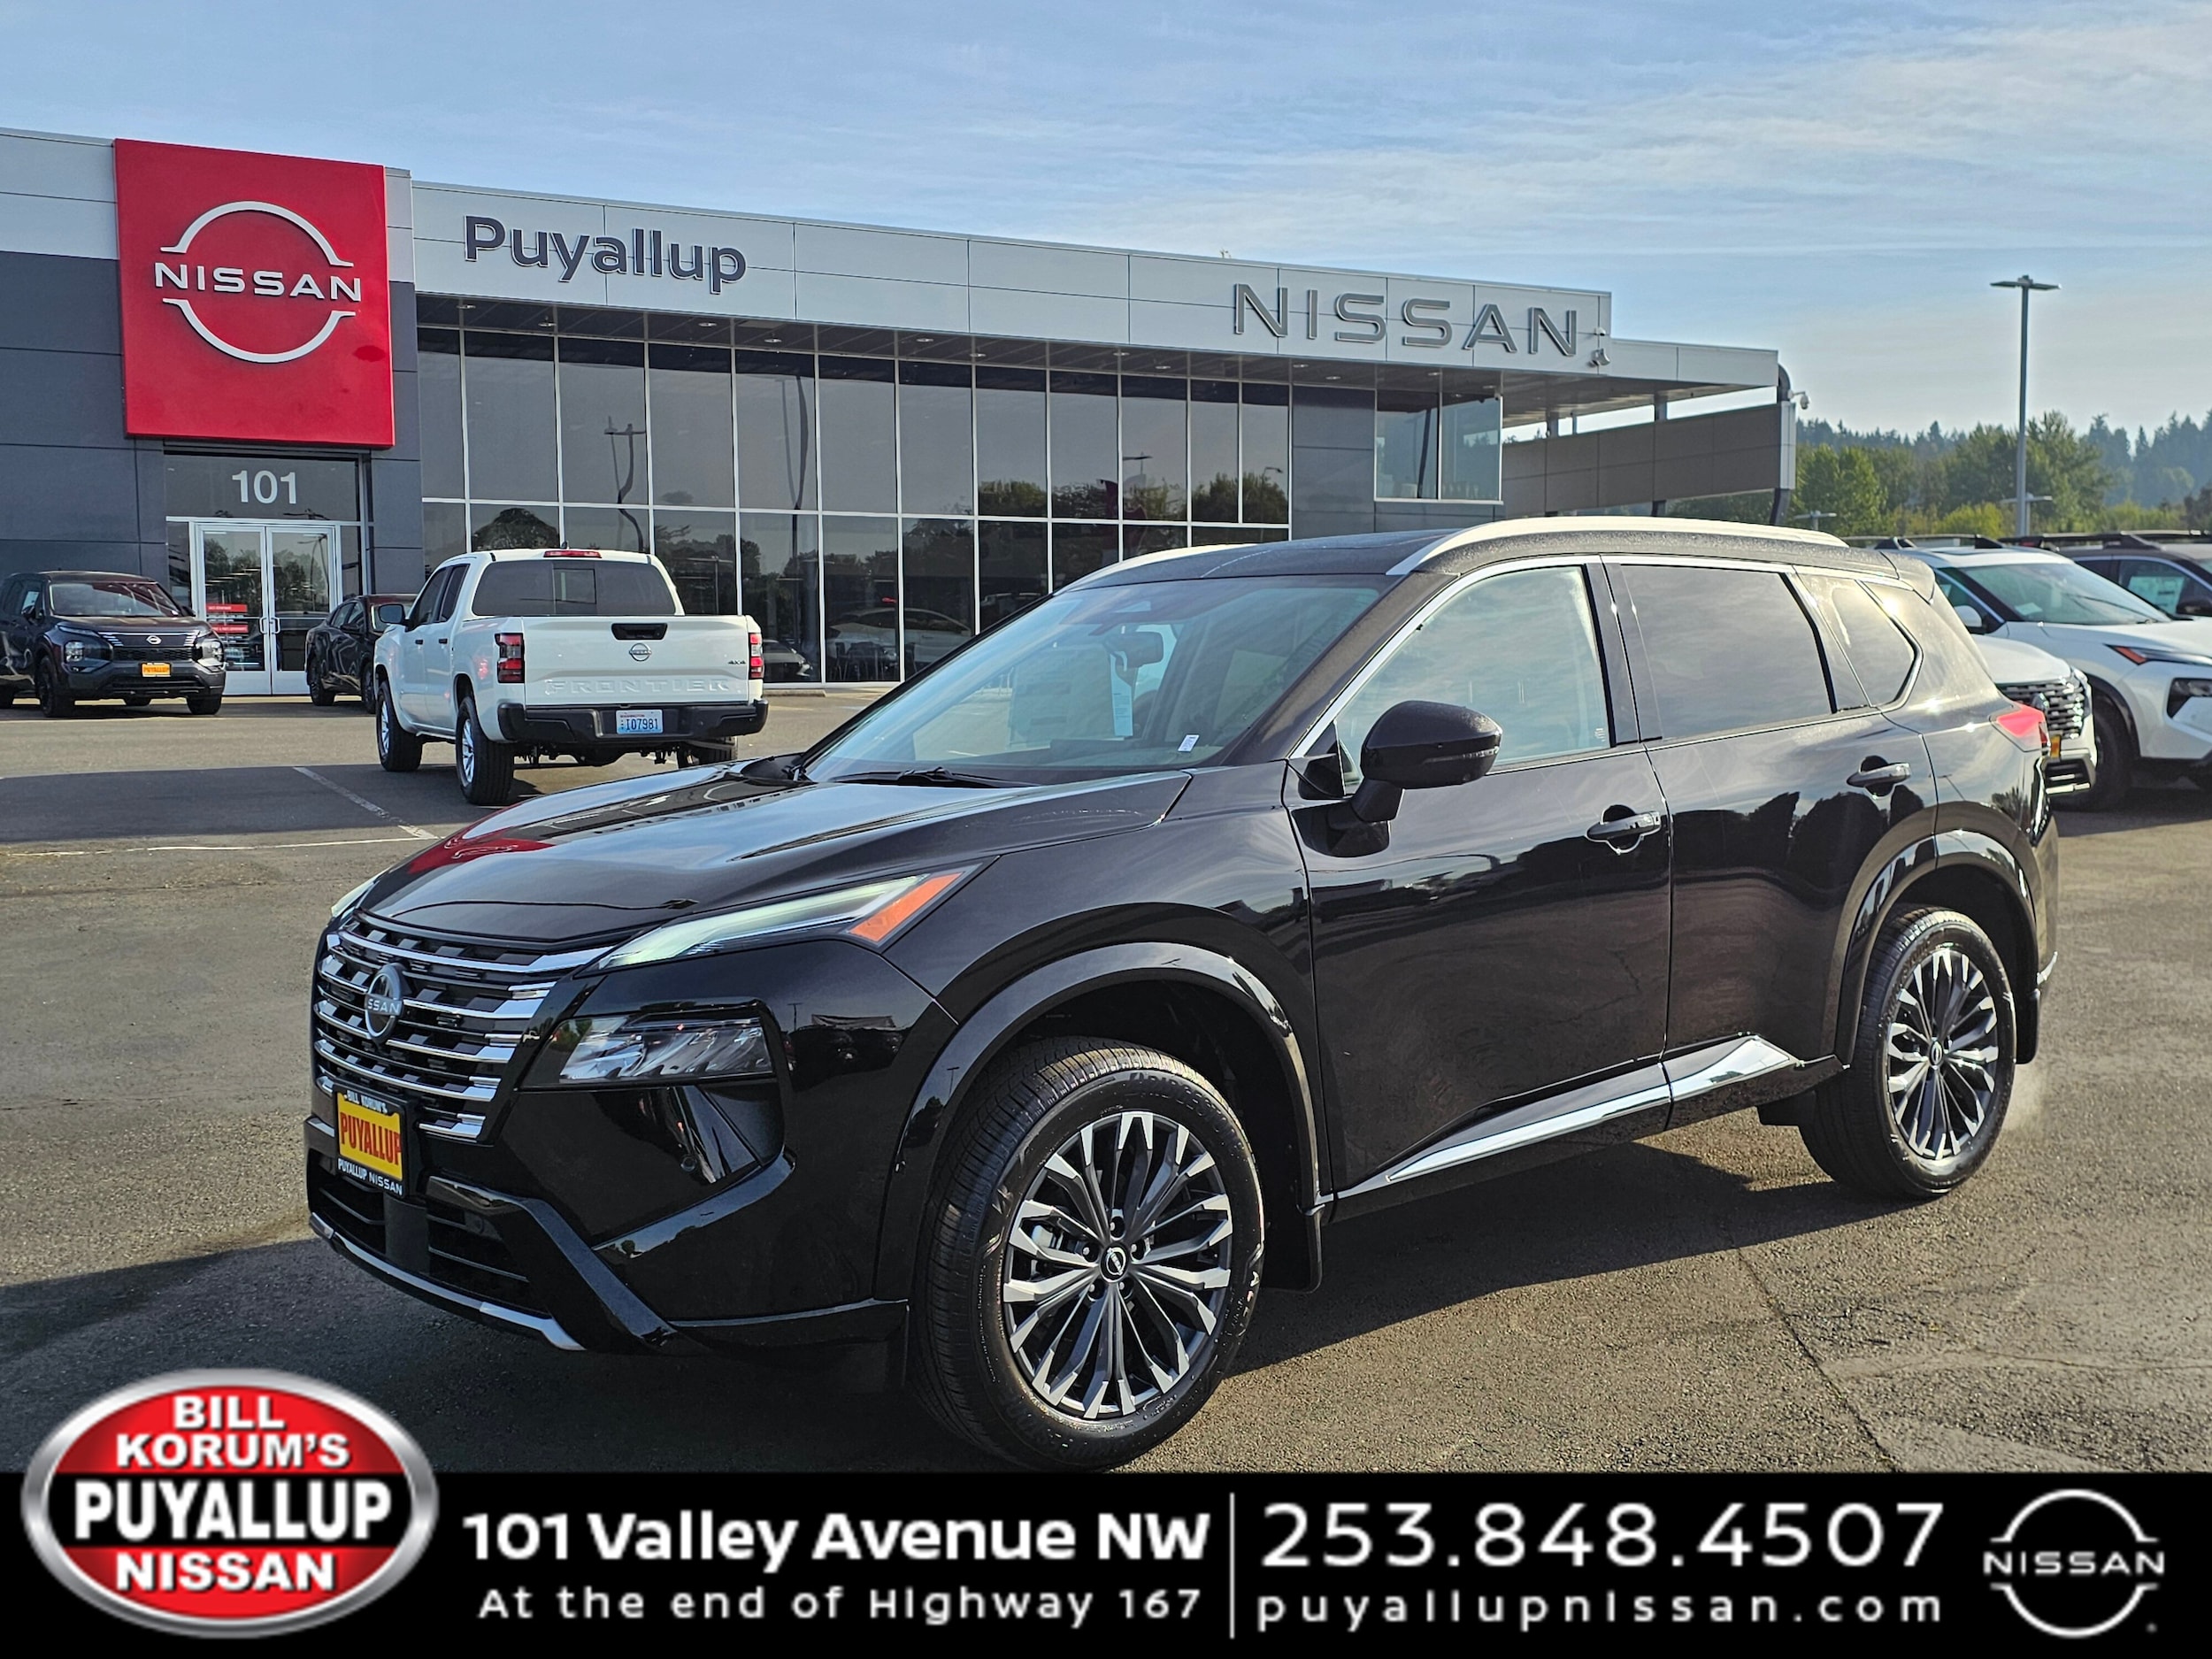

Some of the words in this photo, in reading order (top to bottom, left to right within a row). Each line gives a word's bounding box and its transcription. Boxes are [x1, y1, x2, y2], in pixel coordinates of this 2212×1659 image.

[464, 215, 747, 295] Puyallup
[154, 261, 361, 303] NISSAN
[1234, 282, 1578, 357] NISSAN
[231, 470, 296, 504] 101
[546, 679, 730, 695] FRONTIER
[367, 998, 400, 1016] SSAN
[340, 1111, 402, 1166] PUYALLUP
[337, 1157, 368, 1181] PUYALLUP
[368, 1171, 403, 1196] NISSAN
